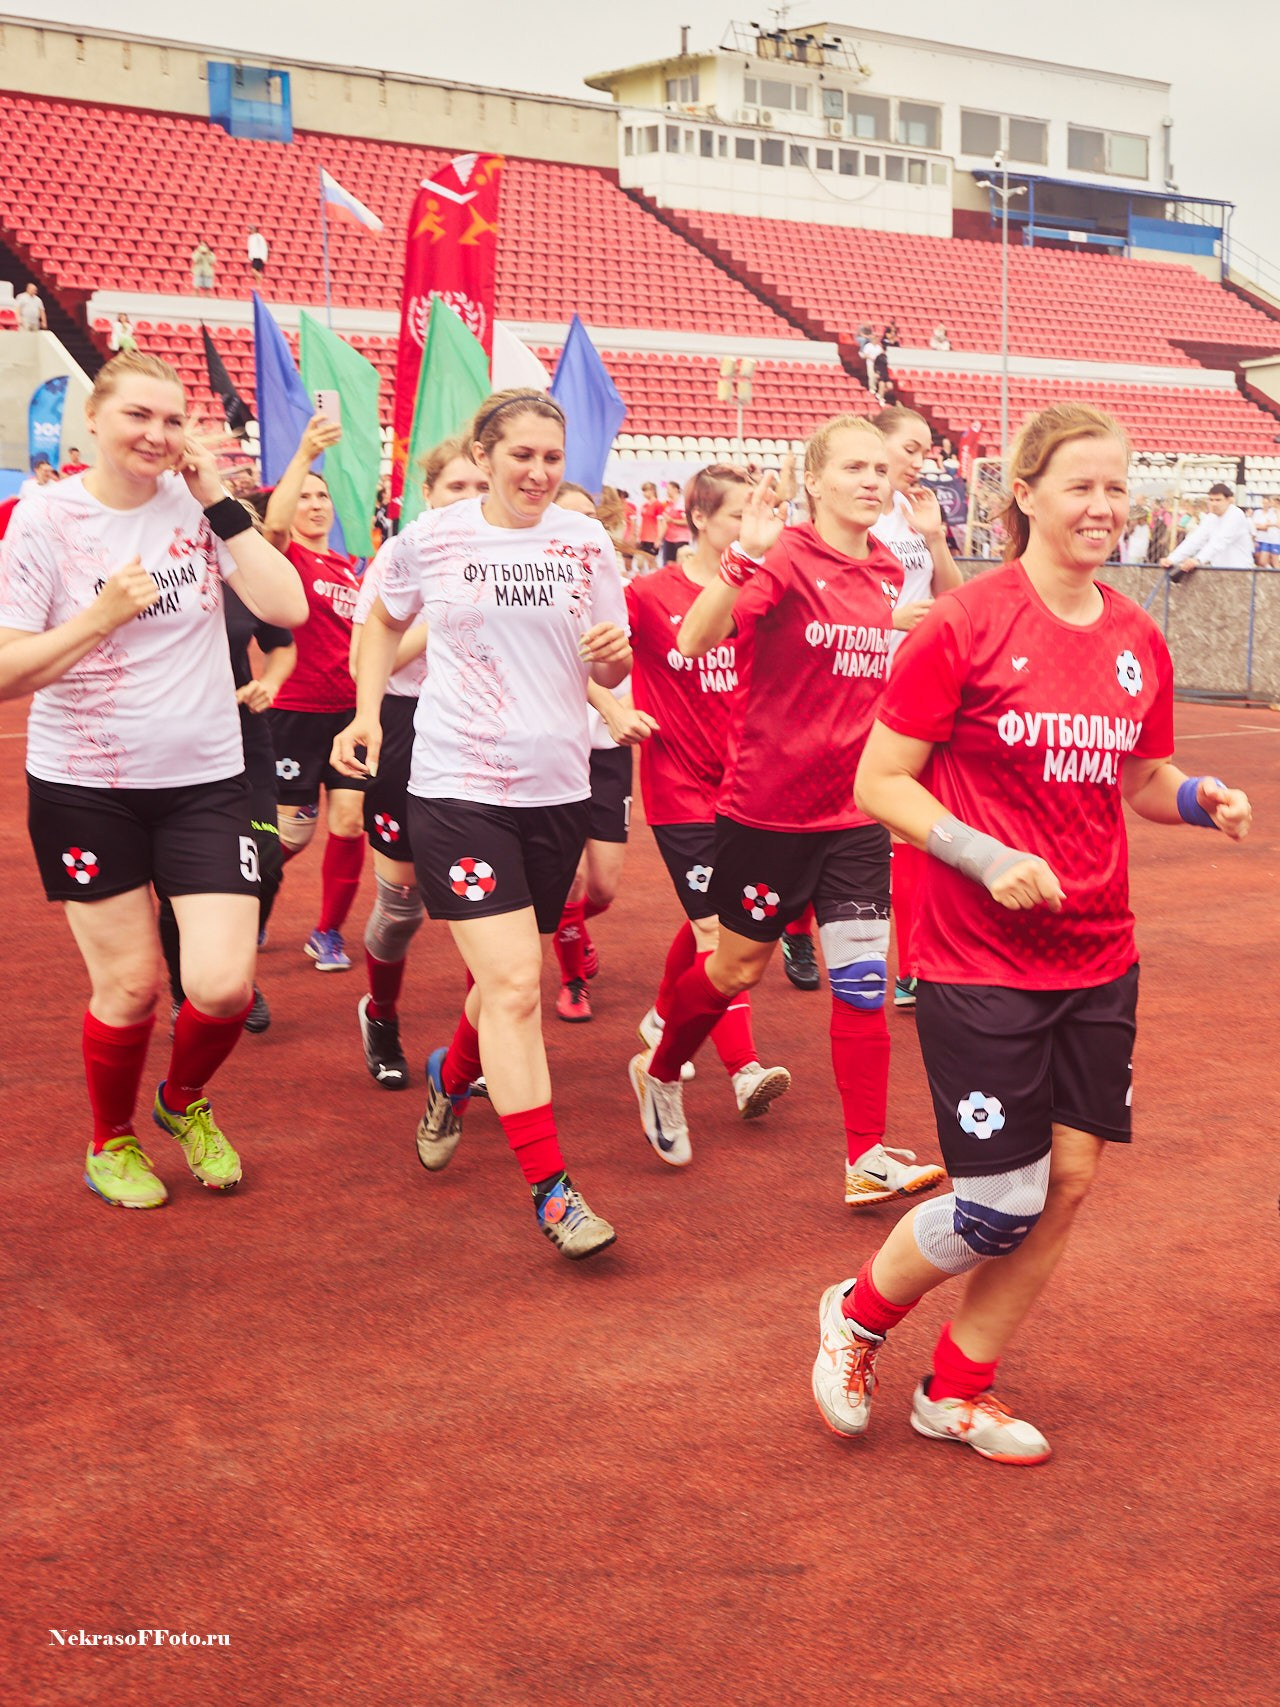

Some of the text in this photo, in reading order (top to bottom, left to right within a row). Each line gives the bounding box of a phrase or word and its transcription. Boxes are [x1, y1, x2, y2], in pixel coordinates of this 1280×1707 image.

[463, 562, 574, 584] ФУТБОЛЬНАЯ
[495, 584, 555, 607] МАМА!
[832, 651, 886, 679] МАМА!
[1042, 749, 1120, 786] МАМА!
